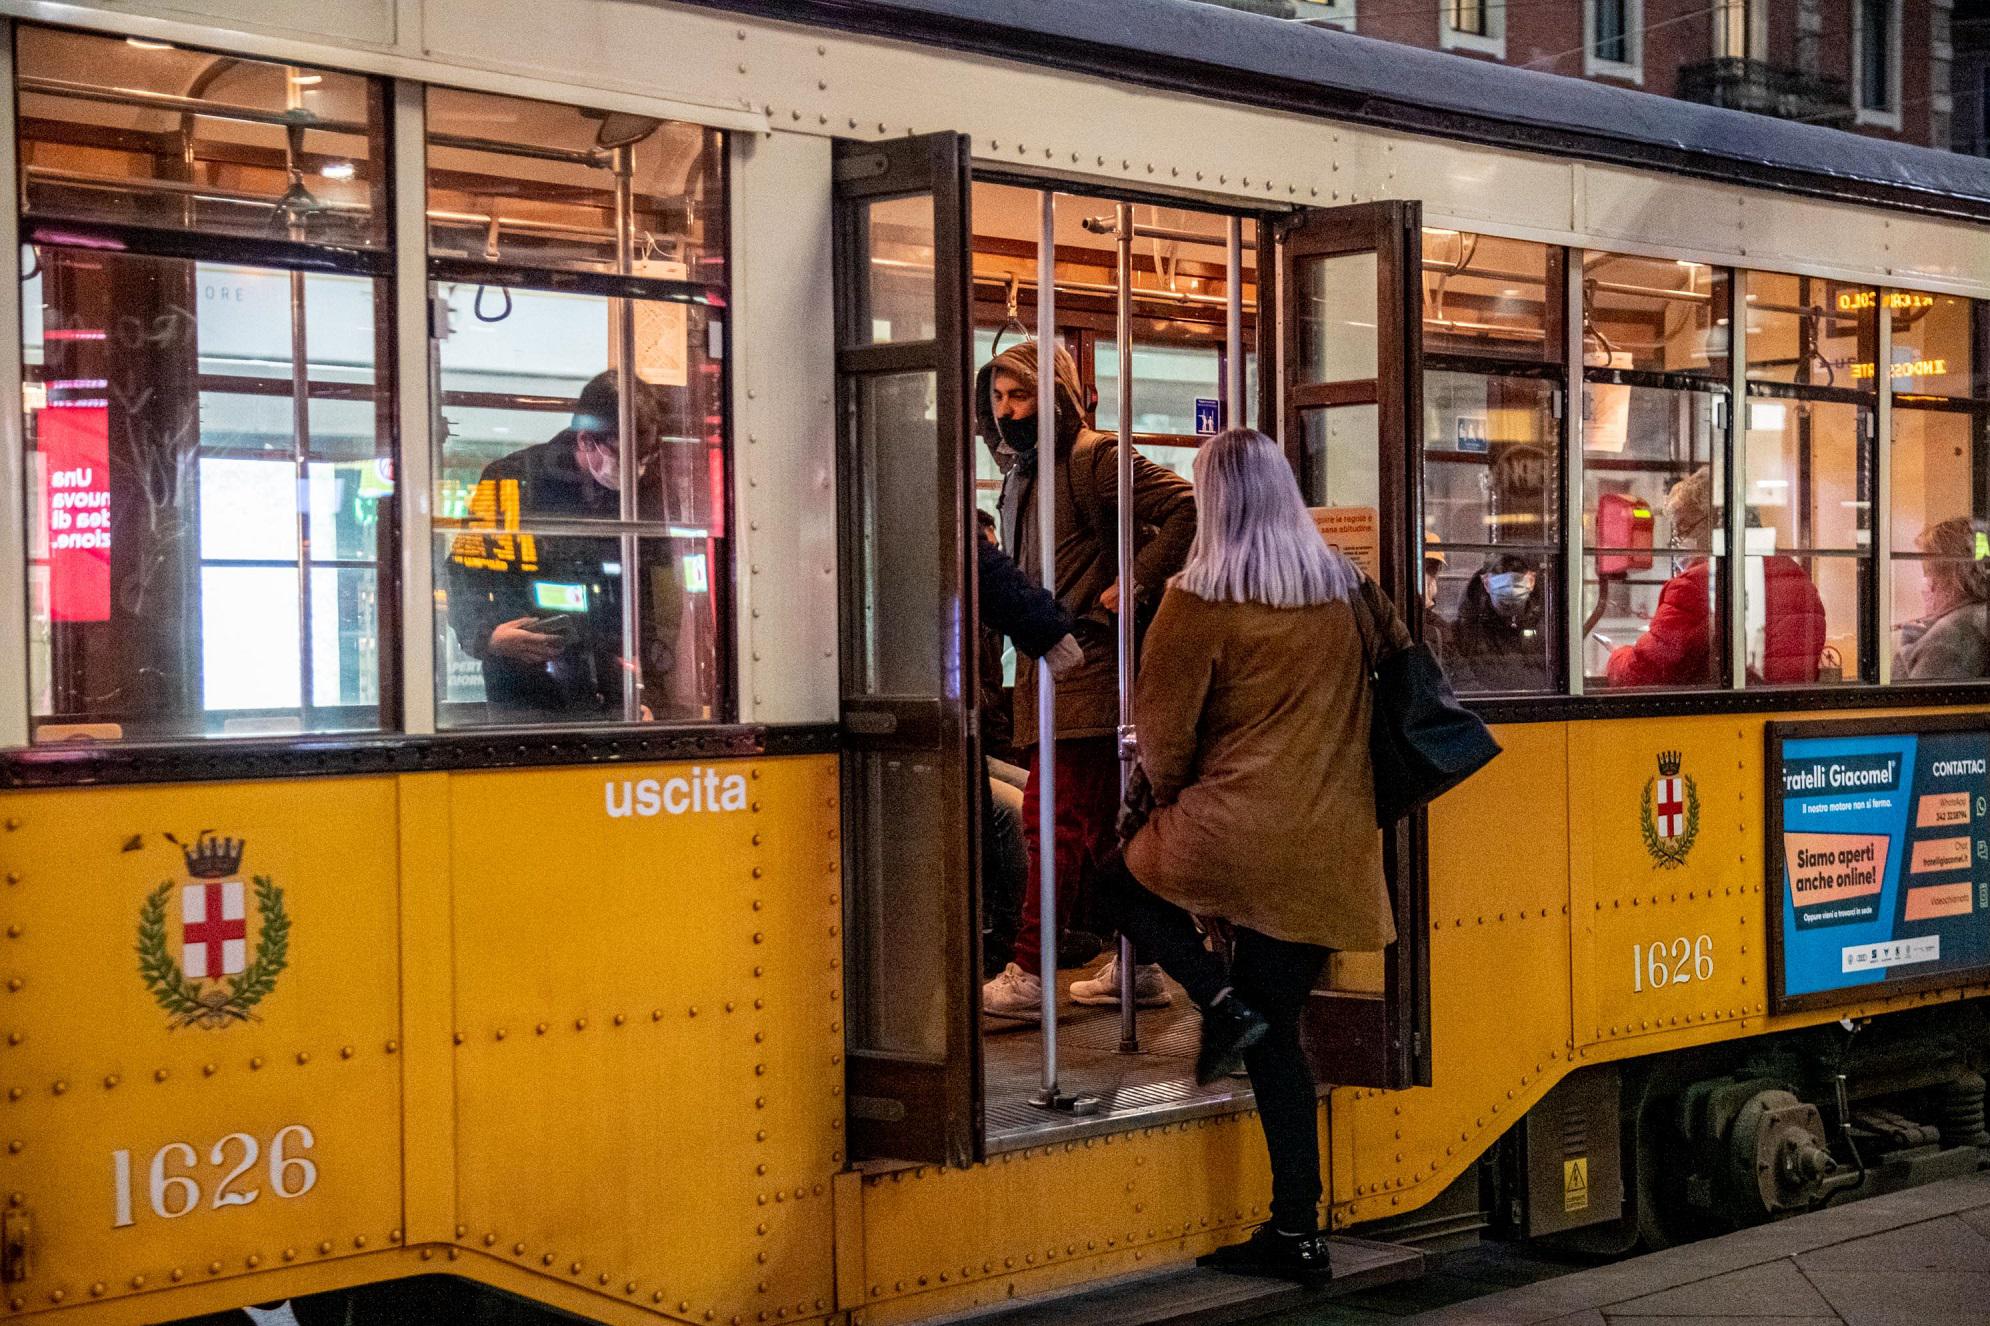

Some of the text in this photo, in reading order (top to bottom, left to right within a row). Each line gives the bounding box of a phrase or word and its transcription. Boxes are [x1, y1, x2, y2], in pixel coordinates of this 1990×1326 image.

[1932, 759, 1986, 777] CONTATTACI
[605, 766, 747, 818] uscita
[1807, 804, 1829, 813] nostro
[1829, 801, 1853, 812] motore
[1797, 842, 1875, 868] Siamo aperti
[1796, 866, 1876, 892] anche online!
[1803, 912, 1822, 923] Oppure
[1633, 934, 1714, 993] 1626
[112, 1124, 318, 1229] 1626
